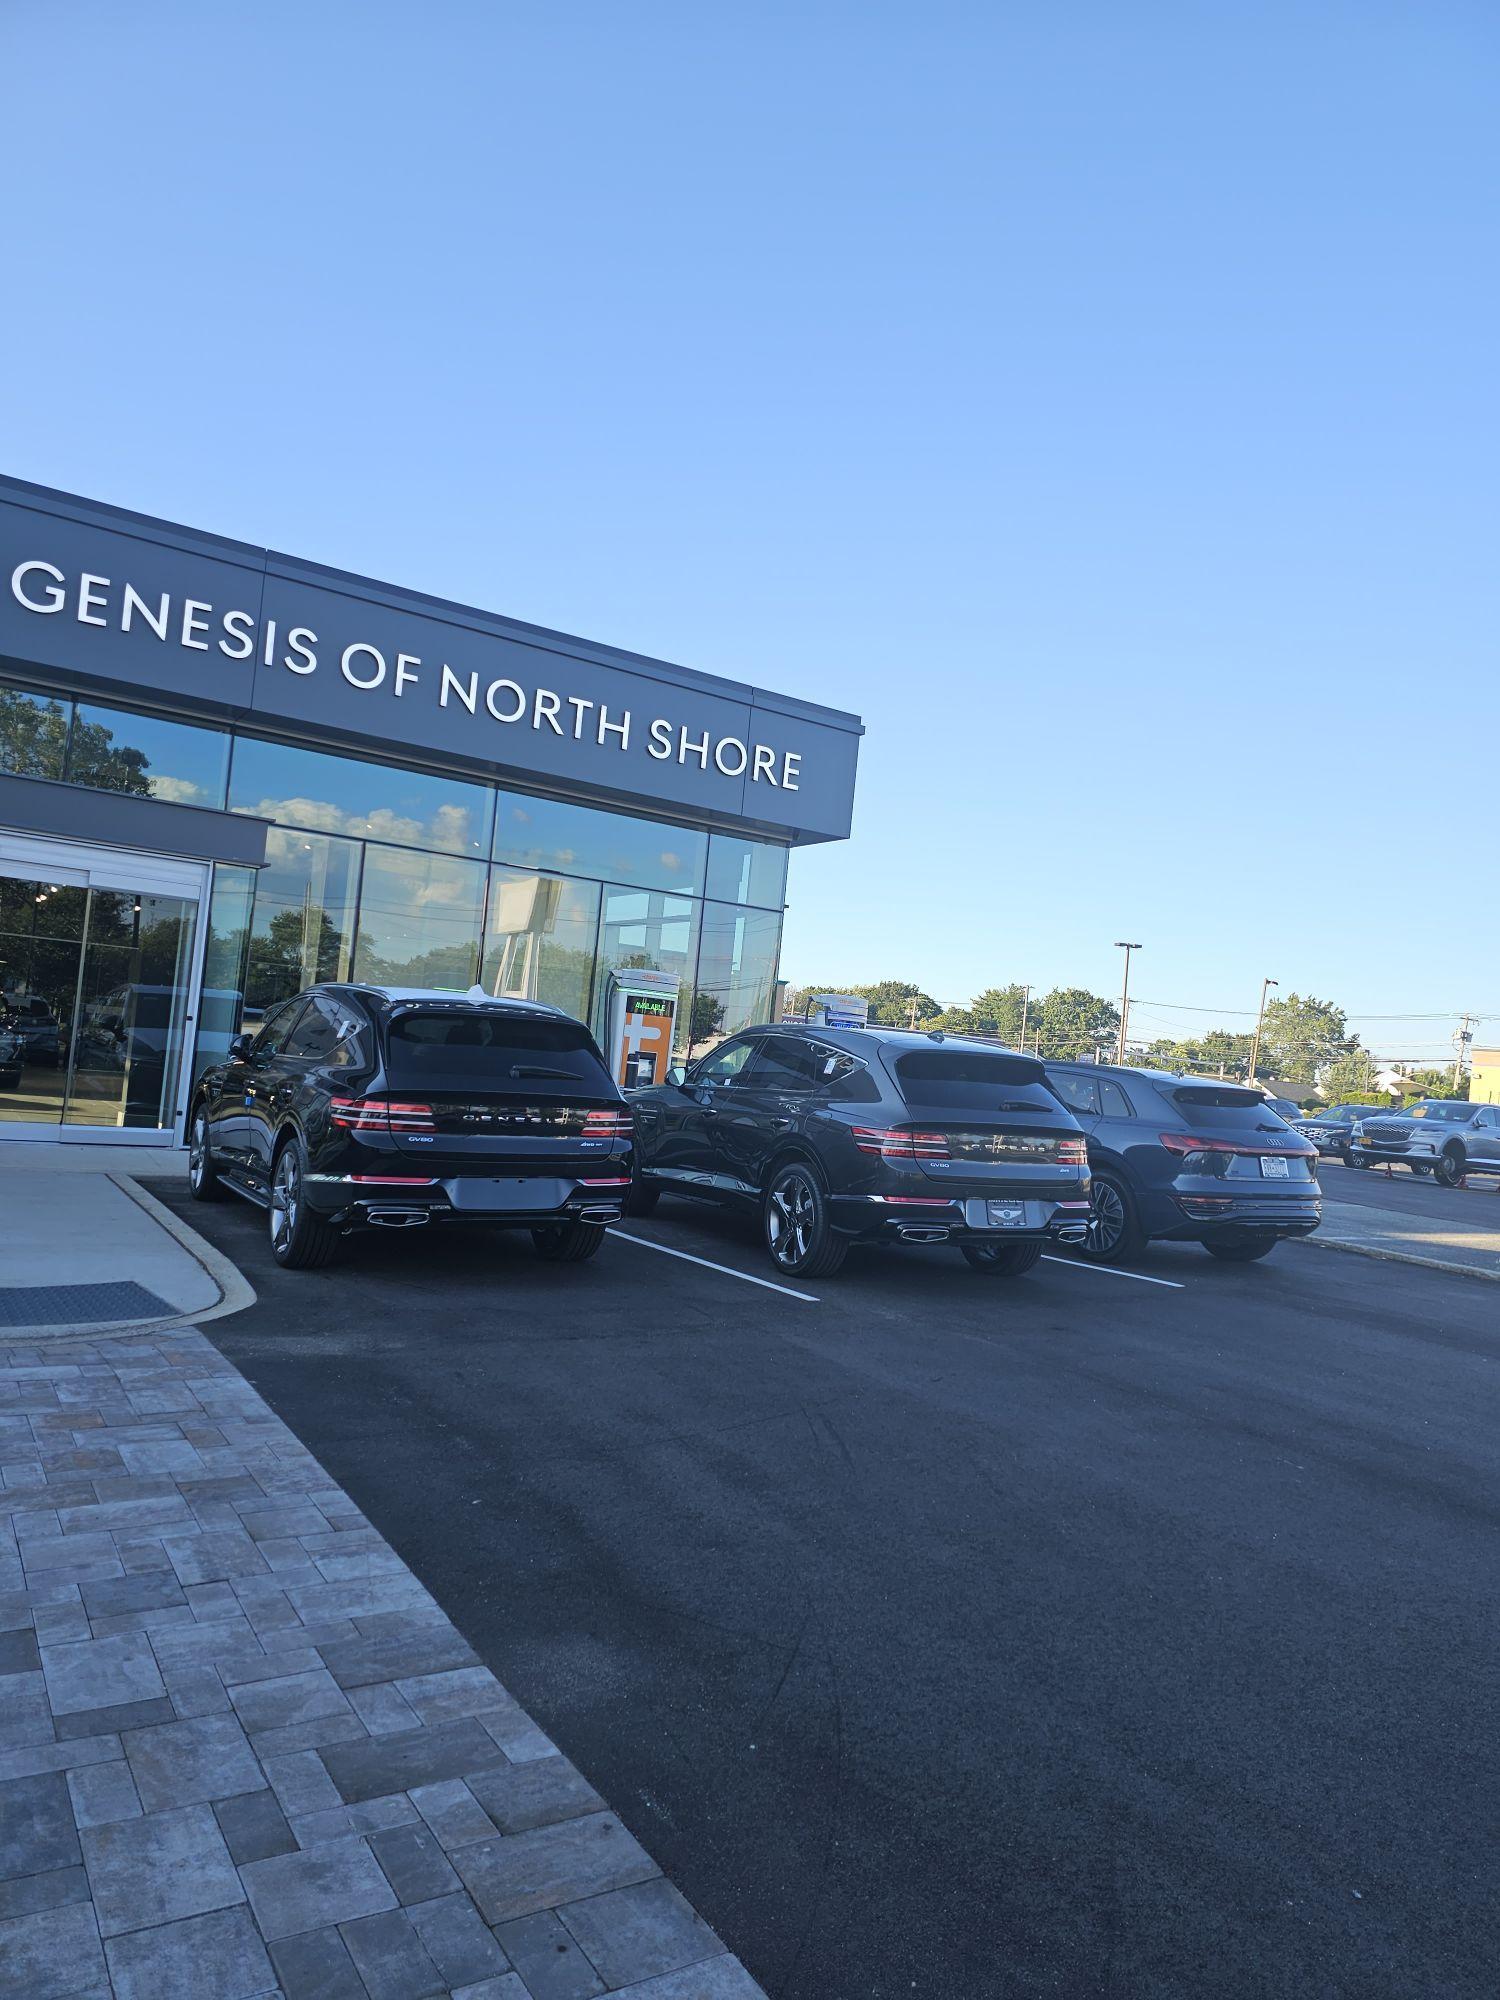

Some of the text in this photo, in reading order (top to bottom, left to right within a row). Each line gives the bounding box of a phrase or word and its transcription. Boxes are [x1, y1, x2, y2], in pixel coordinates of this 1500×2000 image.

[11, 560, 802, 791] GENESIS OF NORTH SHORE
[634, 1001, 666, 1012] AVAILABLE
